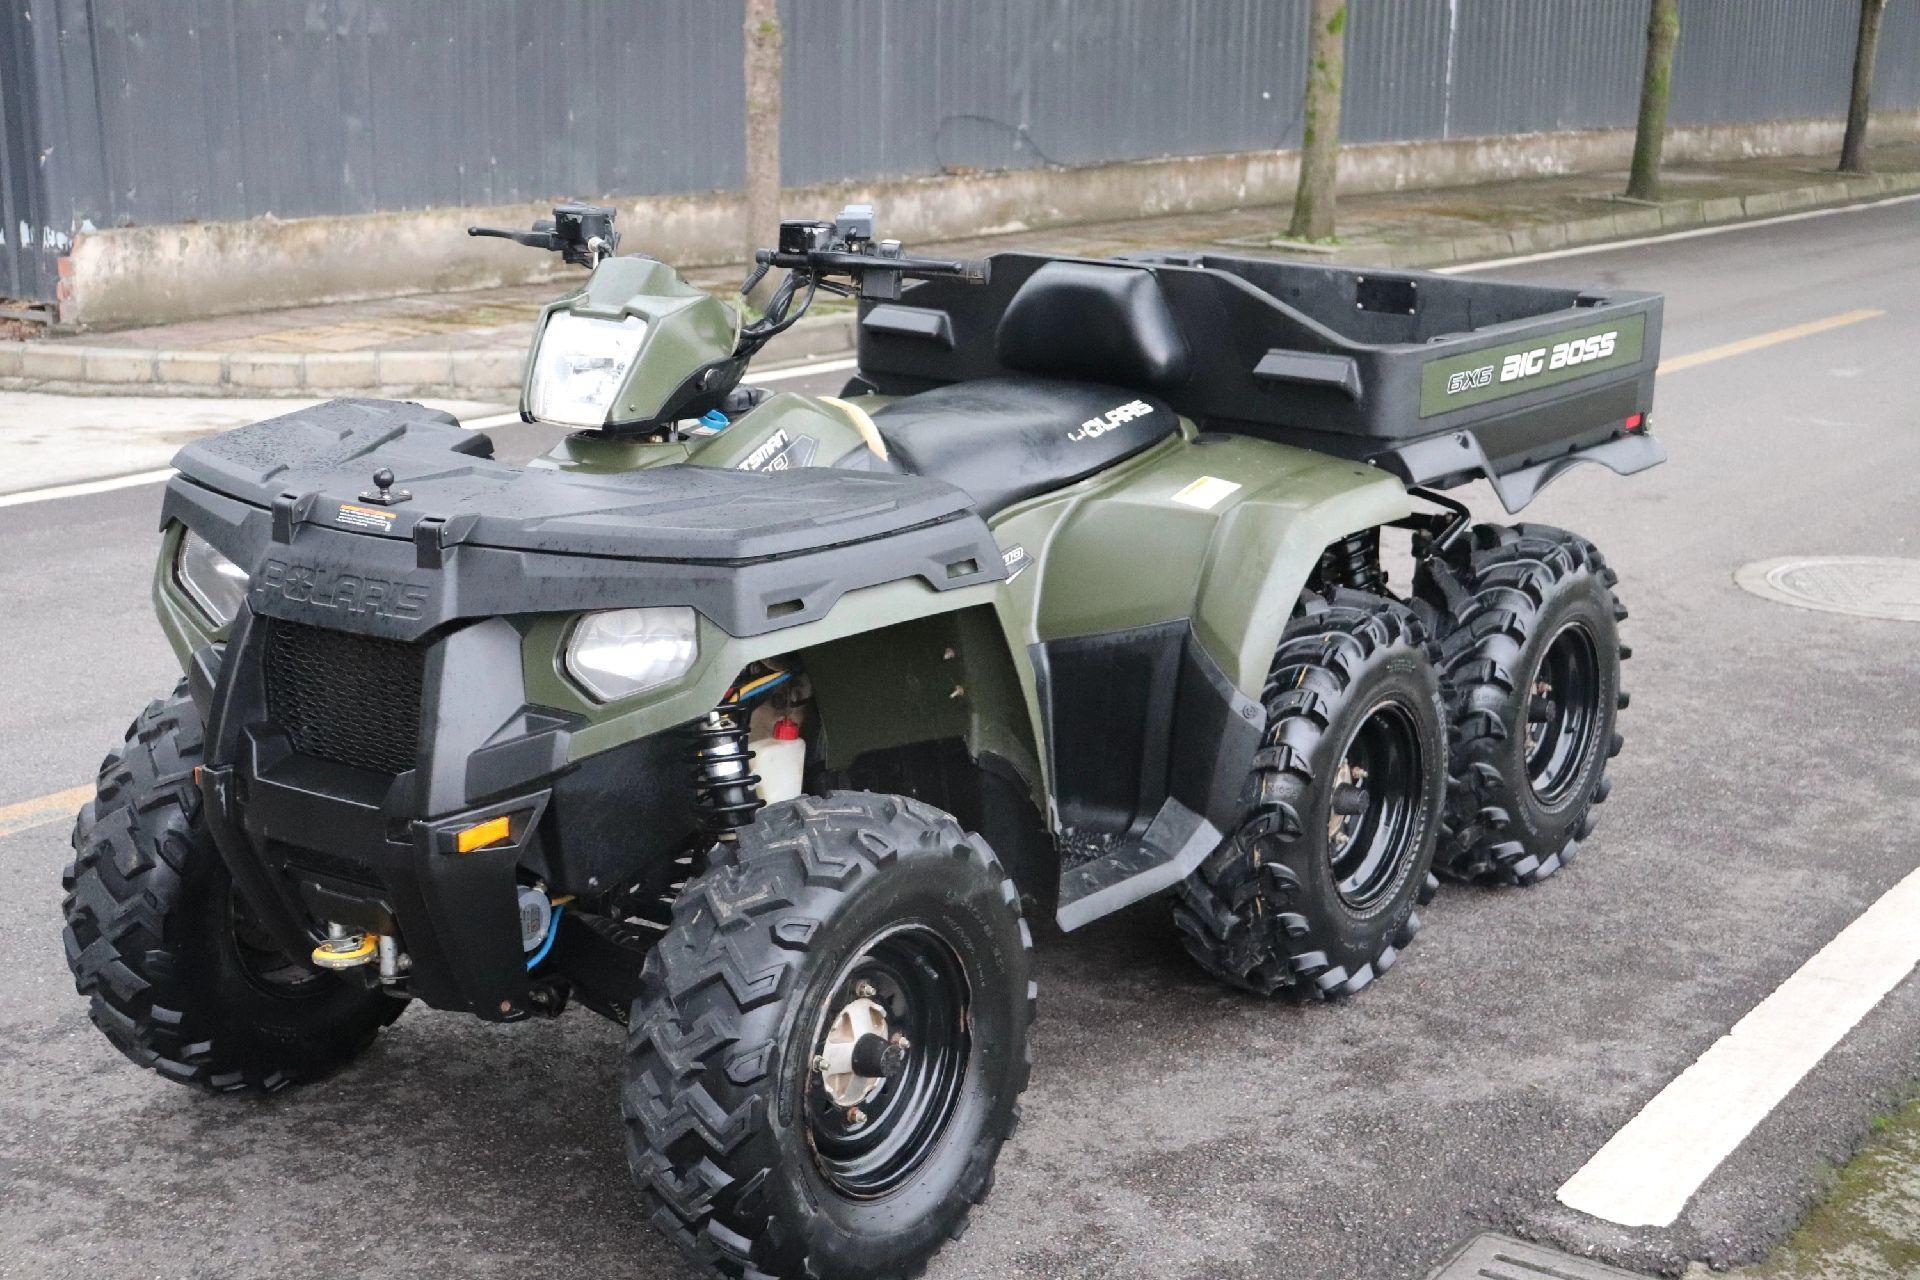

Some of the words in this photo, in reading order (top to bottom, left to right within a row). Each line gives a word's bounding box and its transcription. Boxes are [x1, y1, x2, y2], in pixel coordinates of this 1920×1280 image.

[1500, 348, 1546, 382] BIG
[1549, 331, 1617, 370] BOSS
[256, 557, 432, 621] POLARIS
